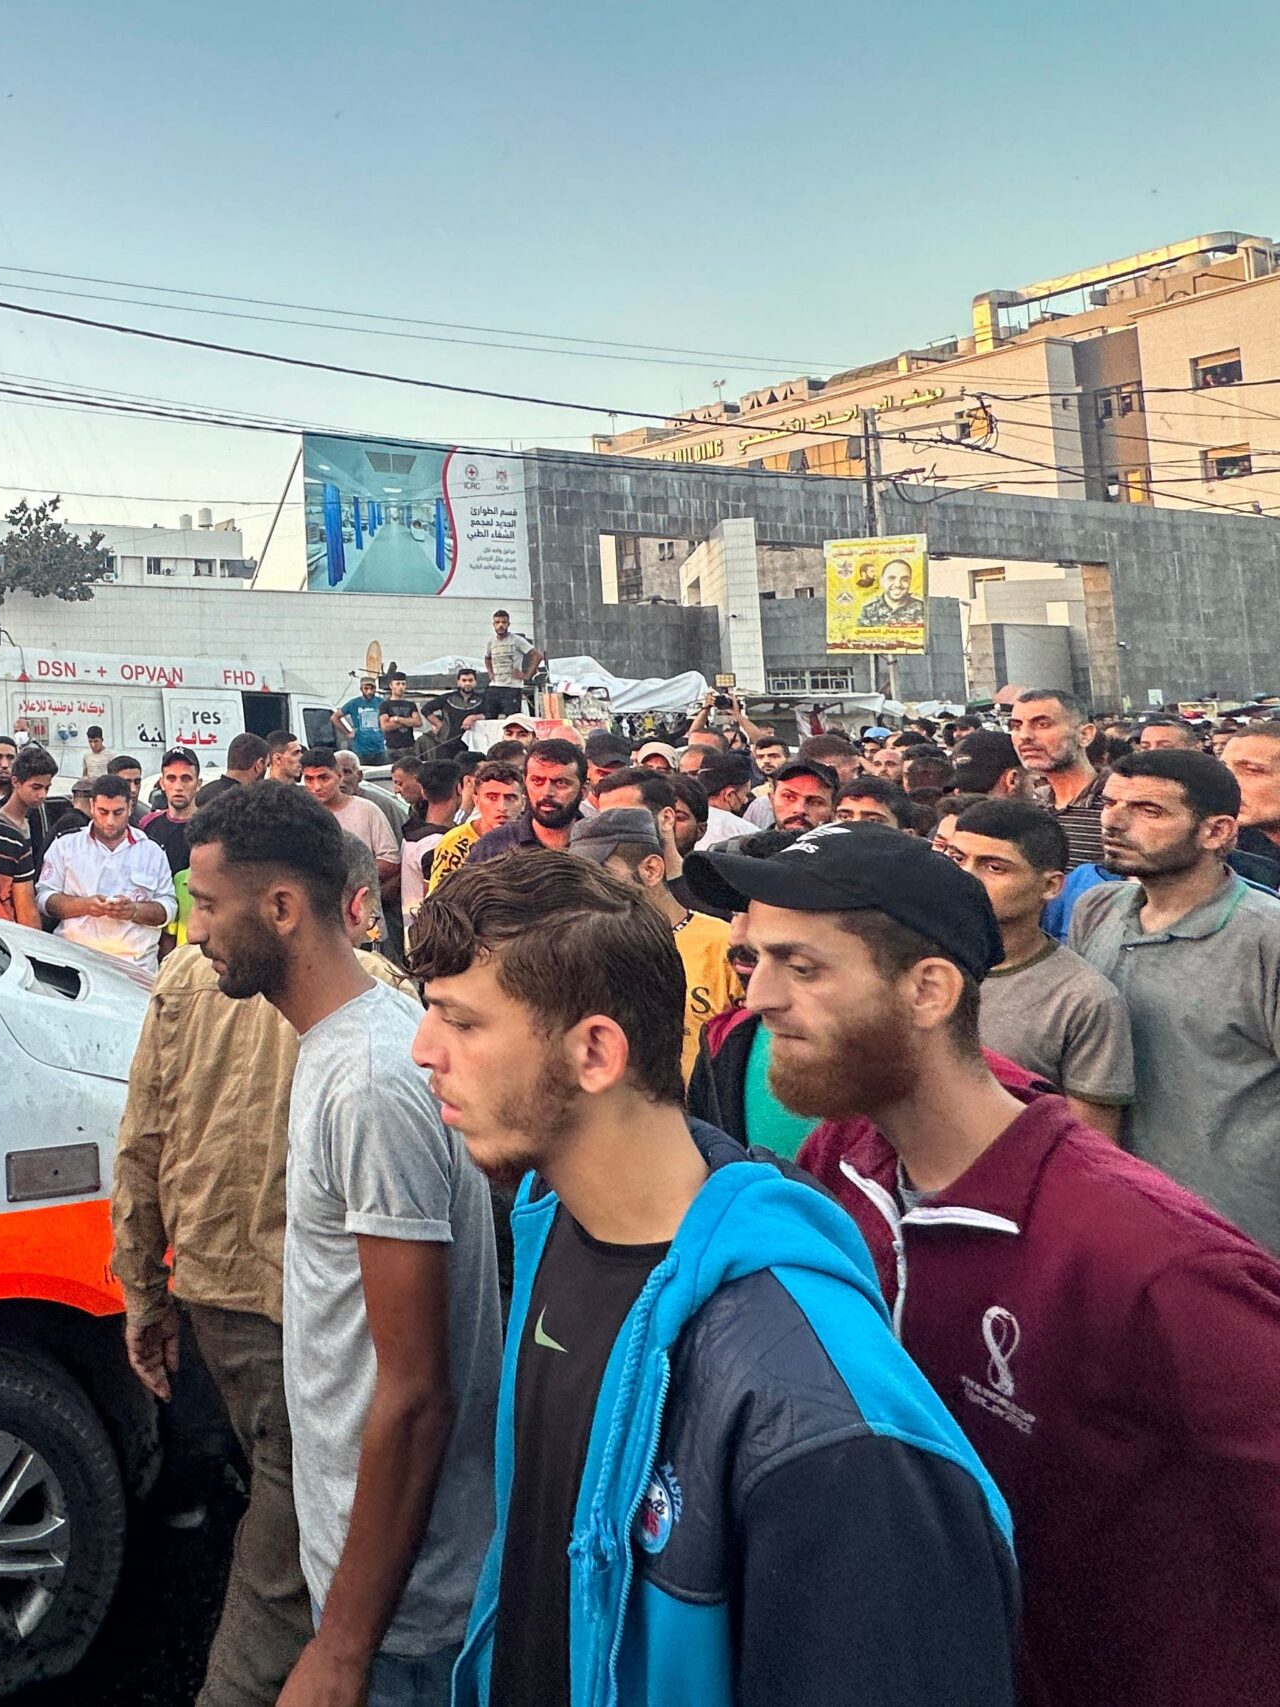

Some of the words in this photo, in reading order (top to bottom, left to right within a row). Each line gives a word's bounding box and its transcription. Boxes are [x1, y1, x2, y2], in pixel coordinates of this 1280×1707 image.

[810, 395, 894, 430] الجاحات
[463, 481, 481, 490] ICRC
[470, 505, 498, 516] الطوارئ
[500, 508, 518, 517] قسم
[495, 519, 517, 529] الجديد
[467, 528, 489, 541] الطبي
[491, 529, 515, 539] الشفاء
[37, 660, 77, 678] DSN
[120, 664, 184, 683] OPVAN
[223, 670, 256, 685] FHD
